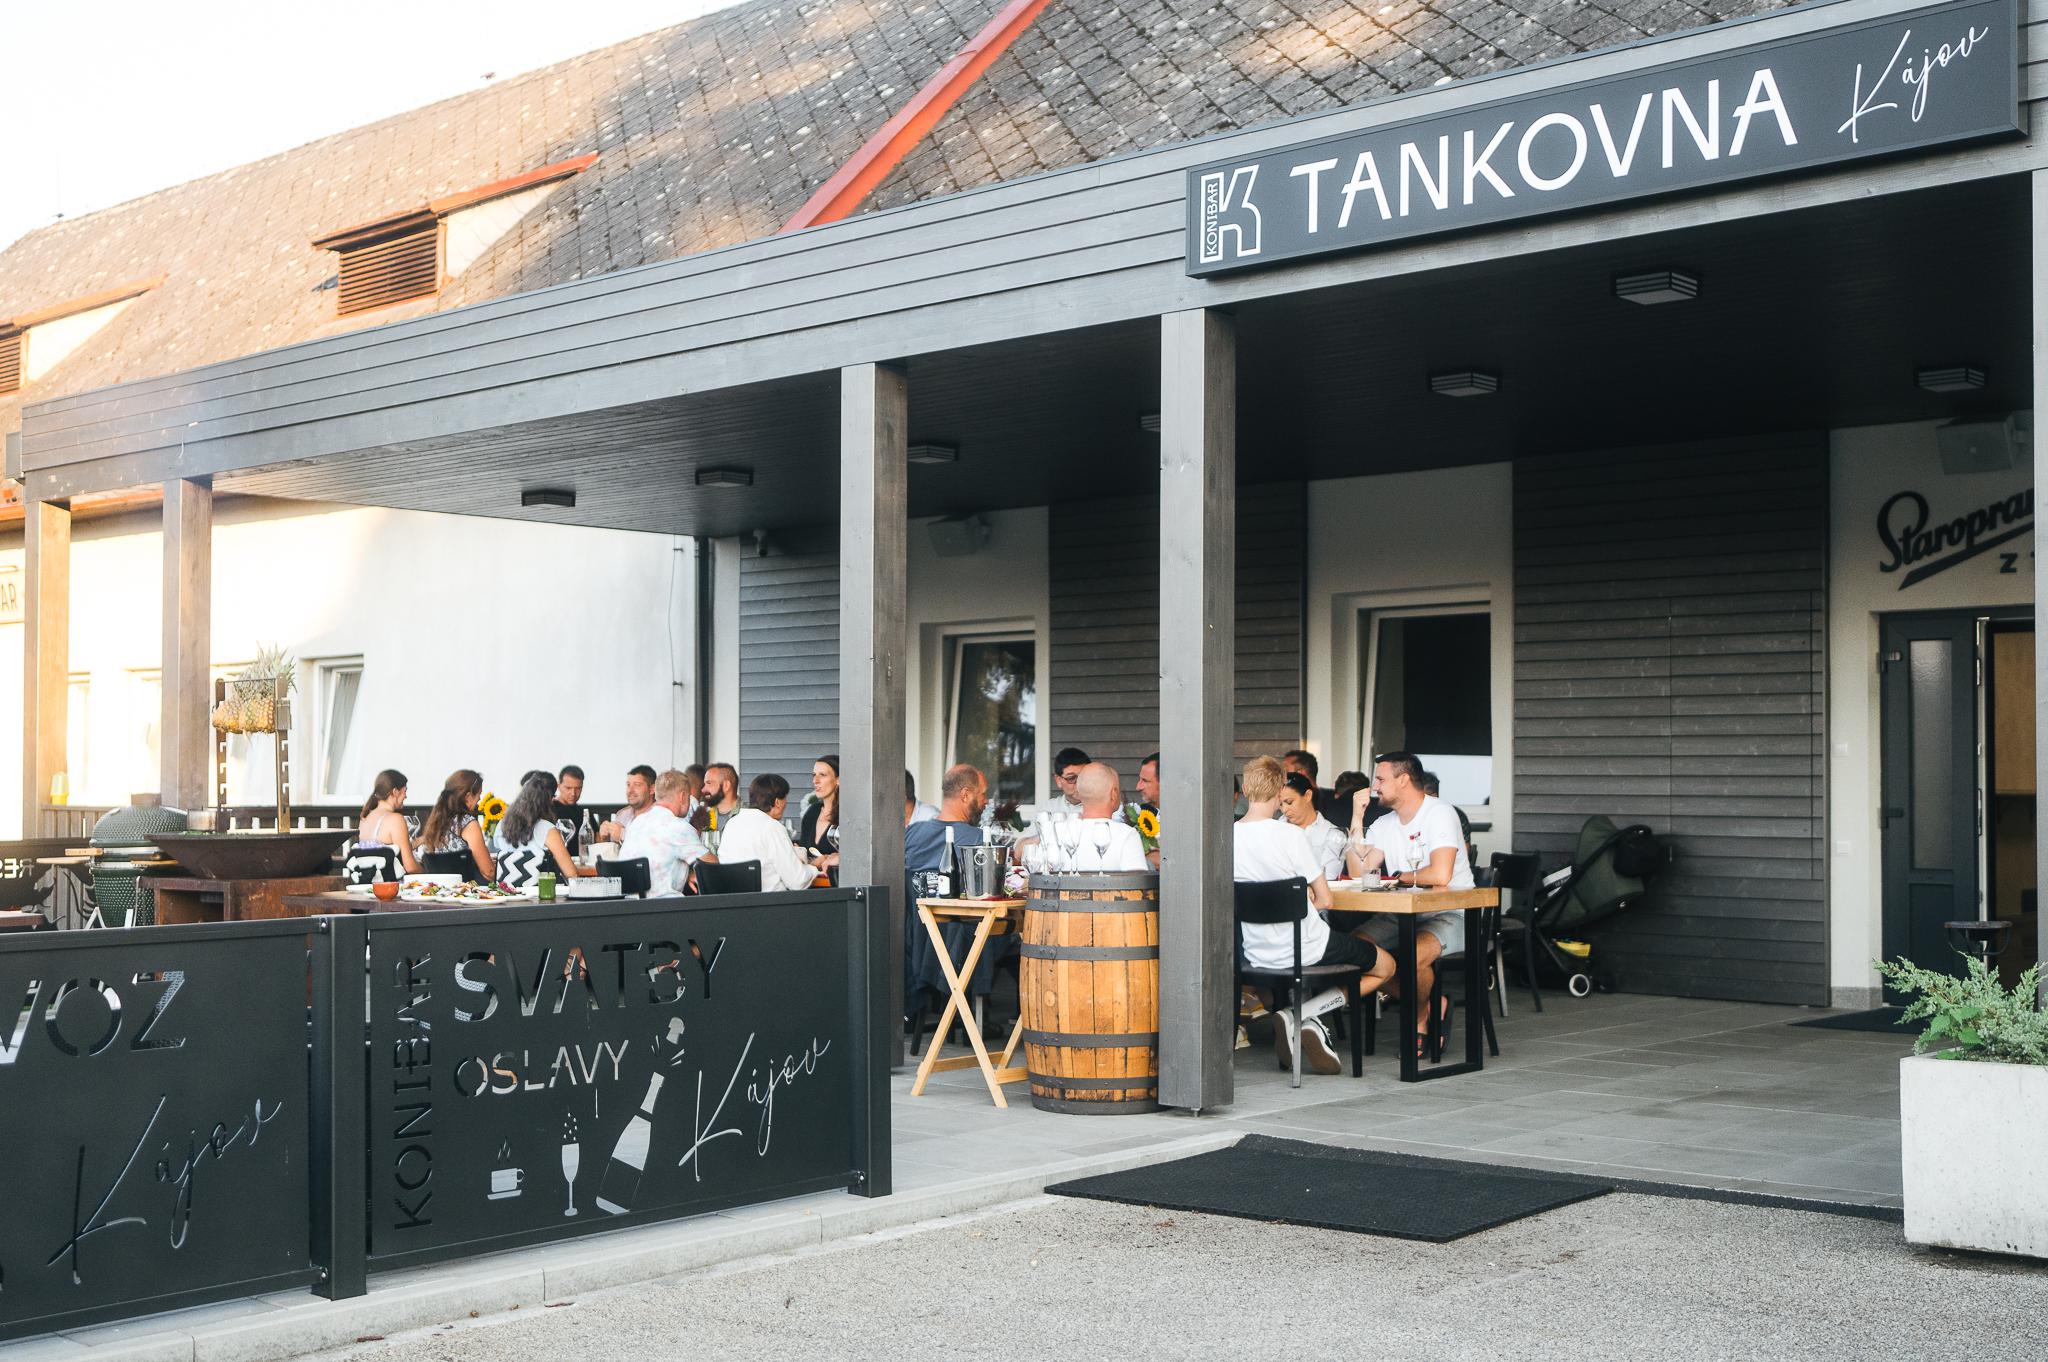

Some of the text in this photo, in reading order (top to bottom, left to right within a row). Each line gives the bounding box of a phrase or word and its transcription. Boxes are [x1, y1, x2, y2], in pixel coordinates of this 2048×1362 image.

[1289, 68, 1798, 234] TANKOVNA
[1838, 25, 1990, 144] Kájov
[1206, 182, 1219, 256] KONIBAR
[454, 936, 727, 1023] SVATBY
[393, 952, 433, 1230] KONIBAR
[453, 1039, 630, 1099] OSLAVY
[678, 1032, 831, 1182] Kájov
[47, 1094, 283, 1285] Kájov
